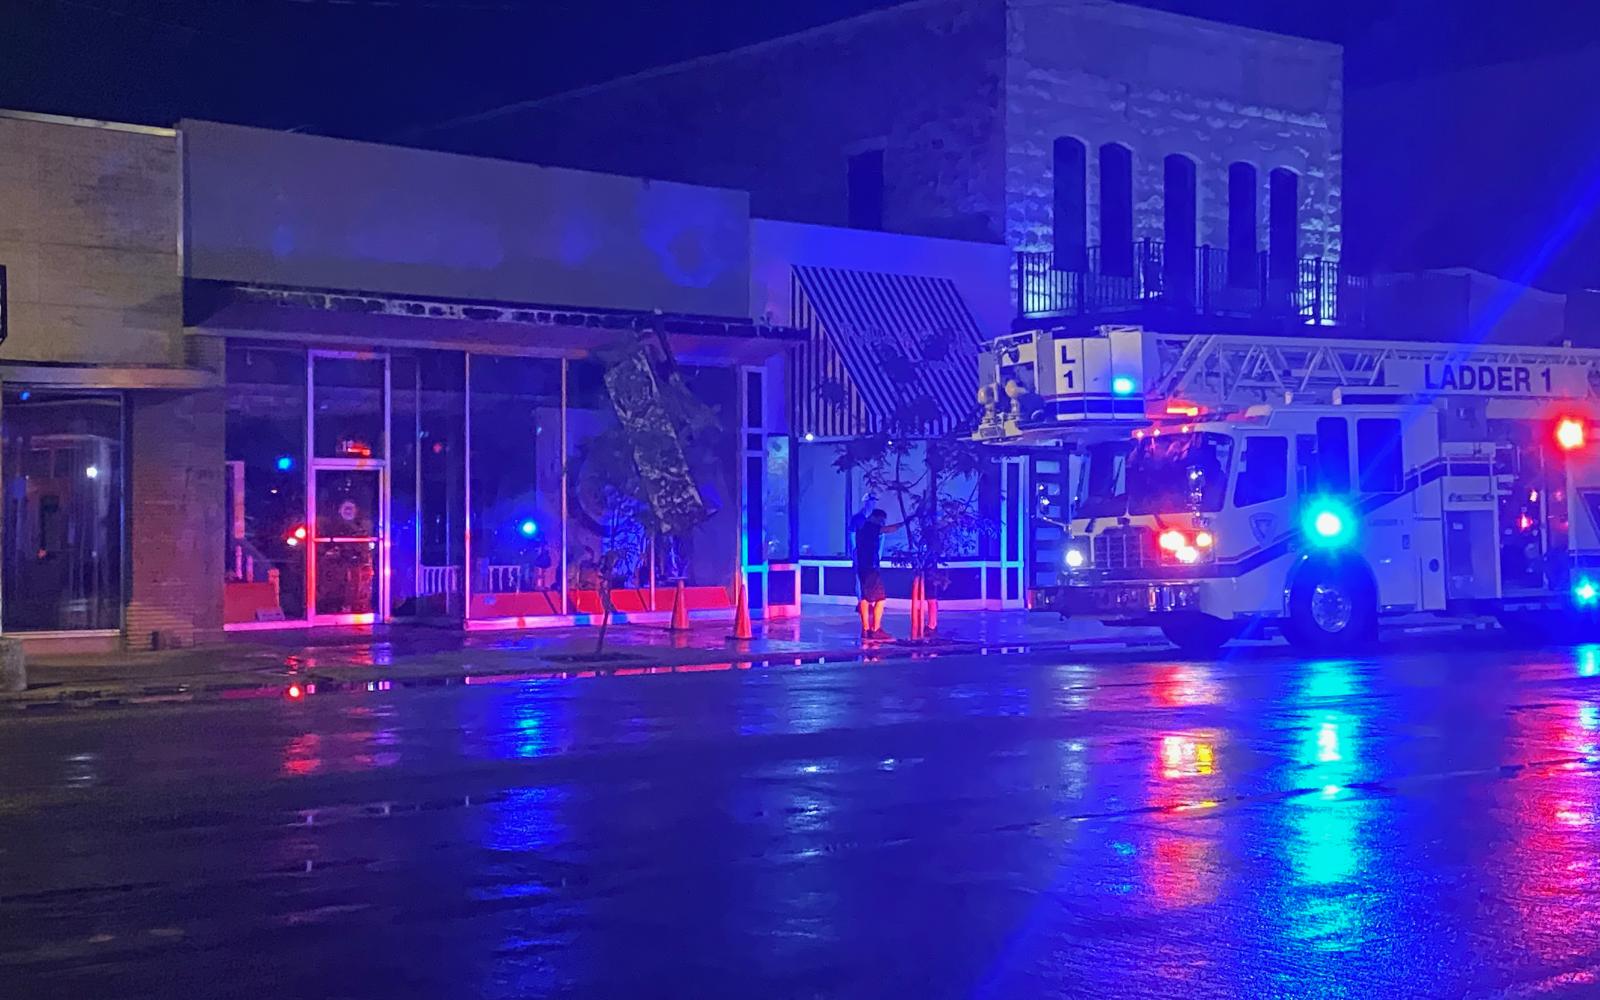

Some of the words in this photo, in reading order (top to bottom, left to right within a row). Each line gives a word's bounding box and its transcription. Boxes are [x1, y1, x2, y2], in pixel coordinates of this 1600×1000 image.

[1061, 345, 1075, 364] L
[1063, 370, 1073, 388] 1
[1424, 363, 1531, 392] LADDER
[1541, 368, 1551, 392] 1
